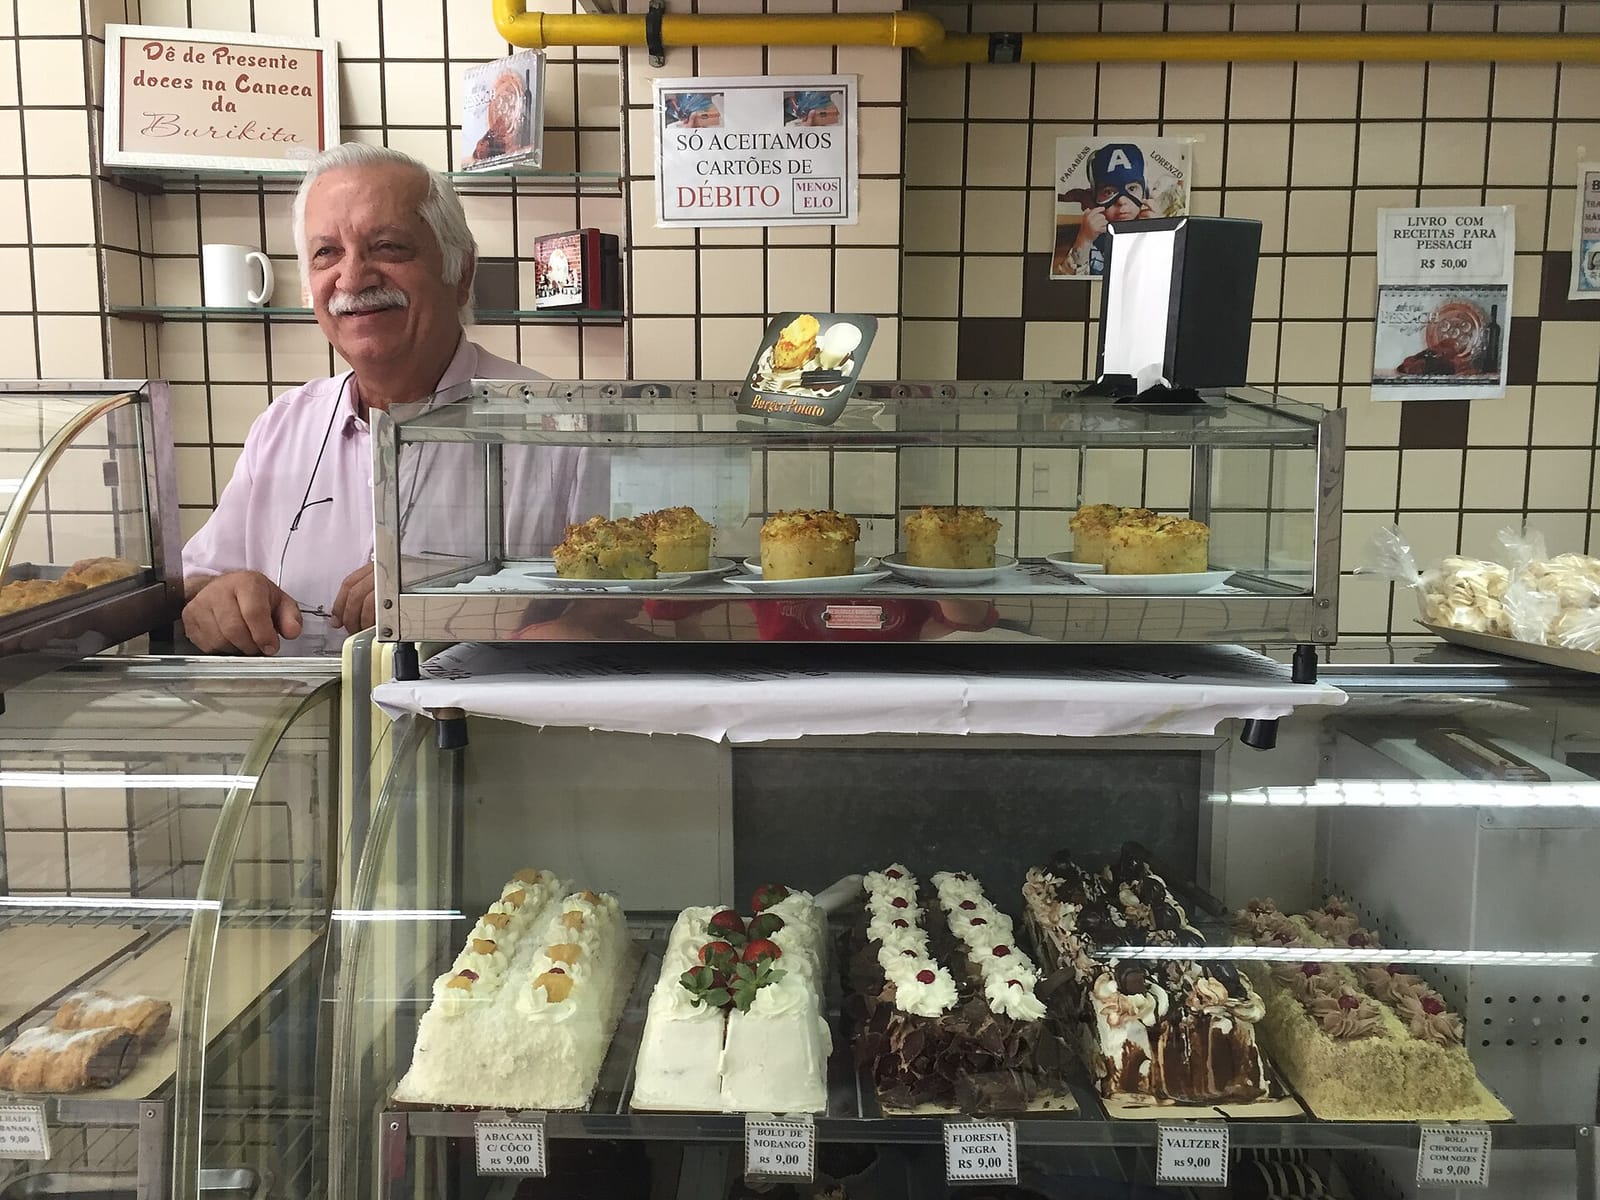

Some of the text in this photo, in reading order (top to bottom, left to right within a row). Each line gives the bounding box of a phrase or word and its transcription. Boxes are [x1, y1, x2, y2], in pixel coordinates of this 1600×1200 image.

[143, 42, 298, 70] Dê de Presente
[133, 70, 312, 97] doces na Caneca
[211, 95, 236, 113] da
[141, 111, 304, 144] Burikita
[677, 129, 832, 151] SÓ ACEITAMOS
[696, 156, 812, 176] CARTÕES DE
[1107, 149, 1132, 173] A
[1150, 150, 1184, 179] LORENZO
[796, 182, 838, 192] MENOS
[677, 180, 780, 208] DÉBITO
[803, 196, 833, 208] ELO
[1407, 216, 1484, 226] LIVRO COM
[1393, 229, 1496, 239] RECEITAS PARA
[1416, 240, 1472, 249] PESSACH
[1420, 259, 1468, 270] R$ 50,00
[751, 394, 786, 413] Burger
[484, 1133, 533, 1141] ABACAXI
[757, 1129, 803, 1138] BOLO DE
[953, 1133, 1004, 1143] FLORESTA
[487, 1142, 532, 1152] C/ CÔCO
[1167, 1138, 1220, 1149] VALTZER
[1429, 1144, 1479, 1153] CHOCOLATE
[961, 1146, 996, 1154] NEGRA
[506, 1155, 530, 1165] 9,00
[775, 1154, 799, 1166] 9,00
[978, 1157, 1002, 1168] 9,00
[1187, 1156, 1211, 1168] 9,00
[1450, 1155, 1477, 1163] NOZES
[1446, 1164, 1470, 1176] 9,00
